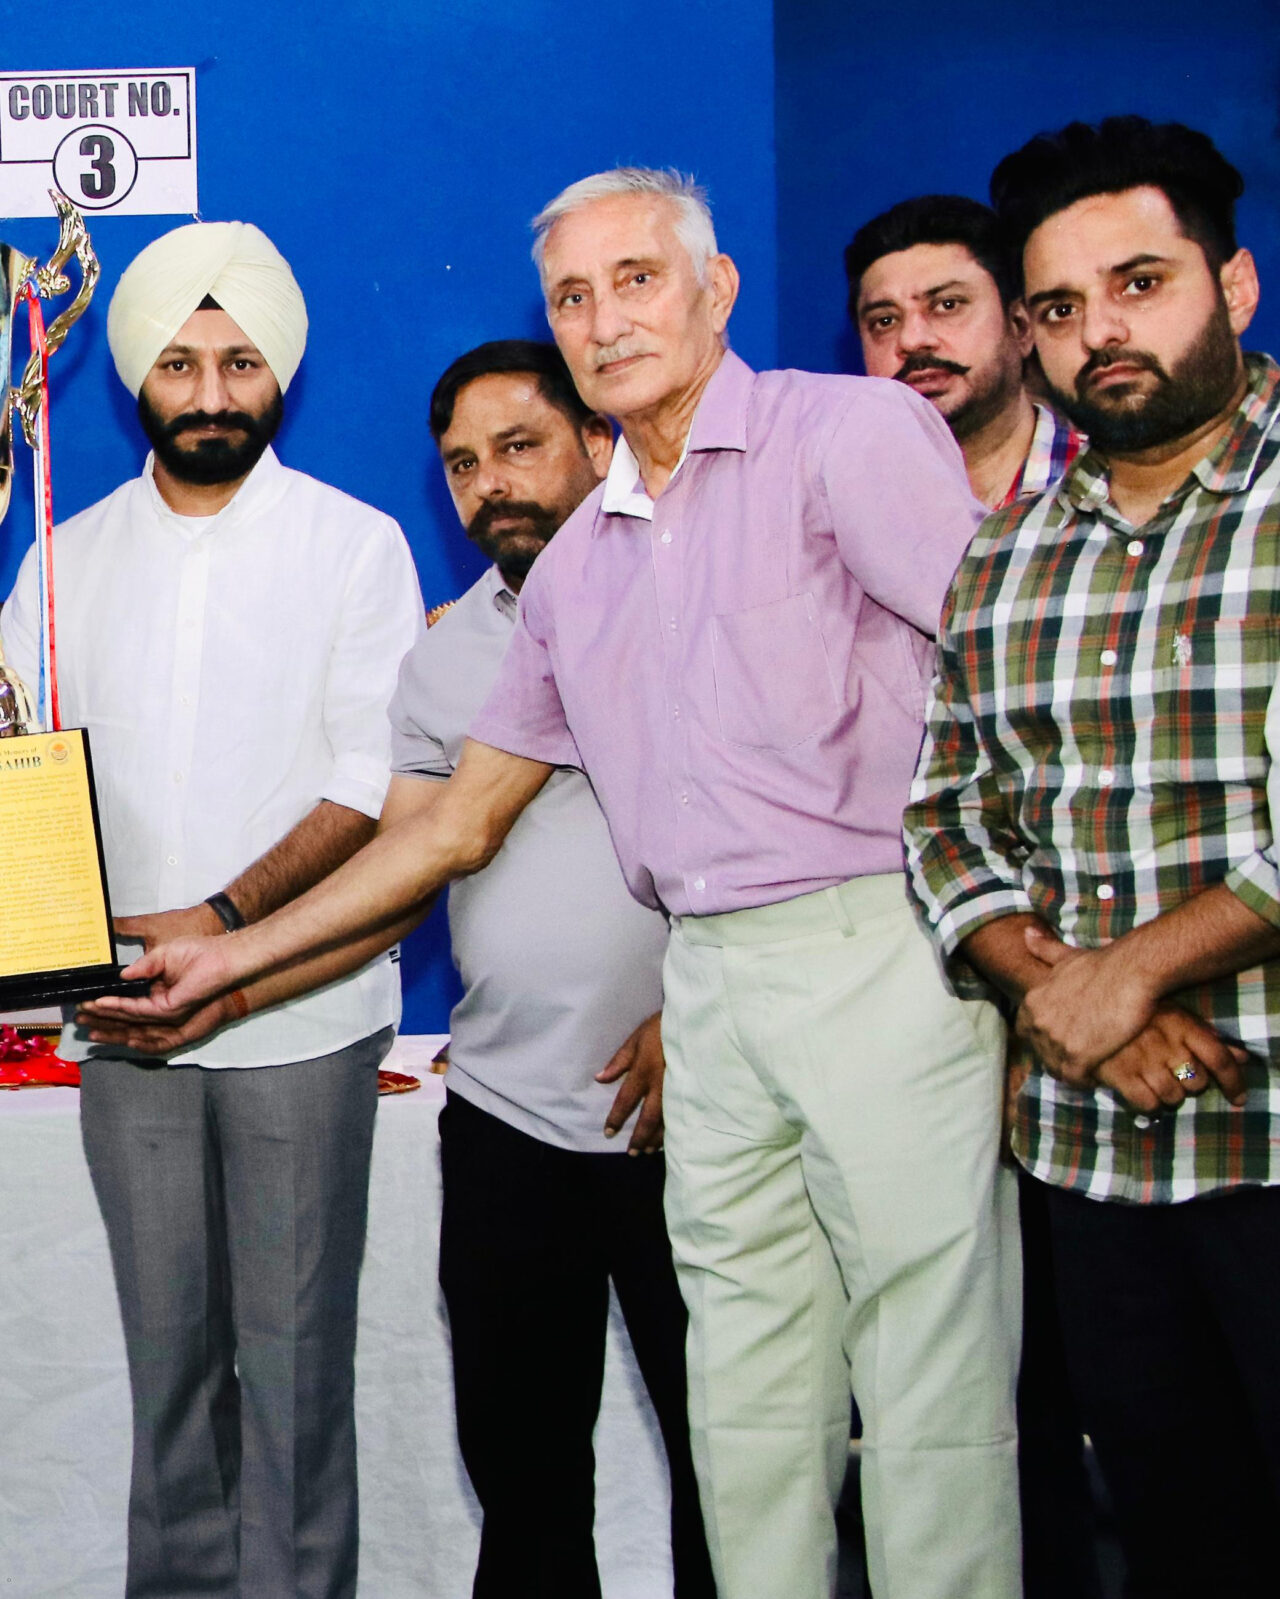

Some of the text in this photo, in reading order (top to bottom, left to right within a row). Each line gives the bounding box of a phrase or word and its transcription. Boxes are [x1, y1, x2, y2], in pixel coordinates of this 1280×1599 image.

[8, 80, 180, 121] COURT NO.
[78, 134, 116, 200] 3
